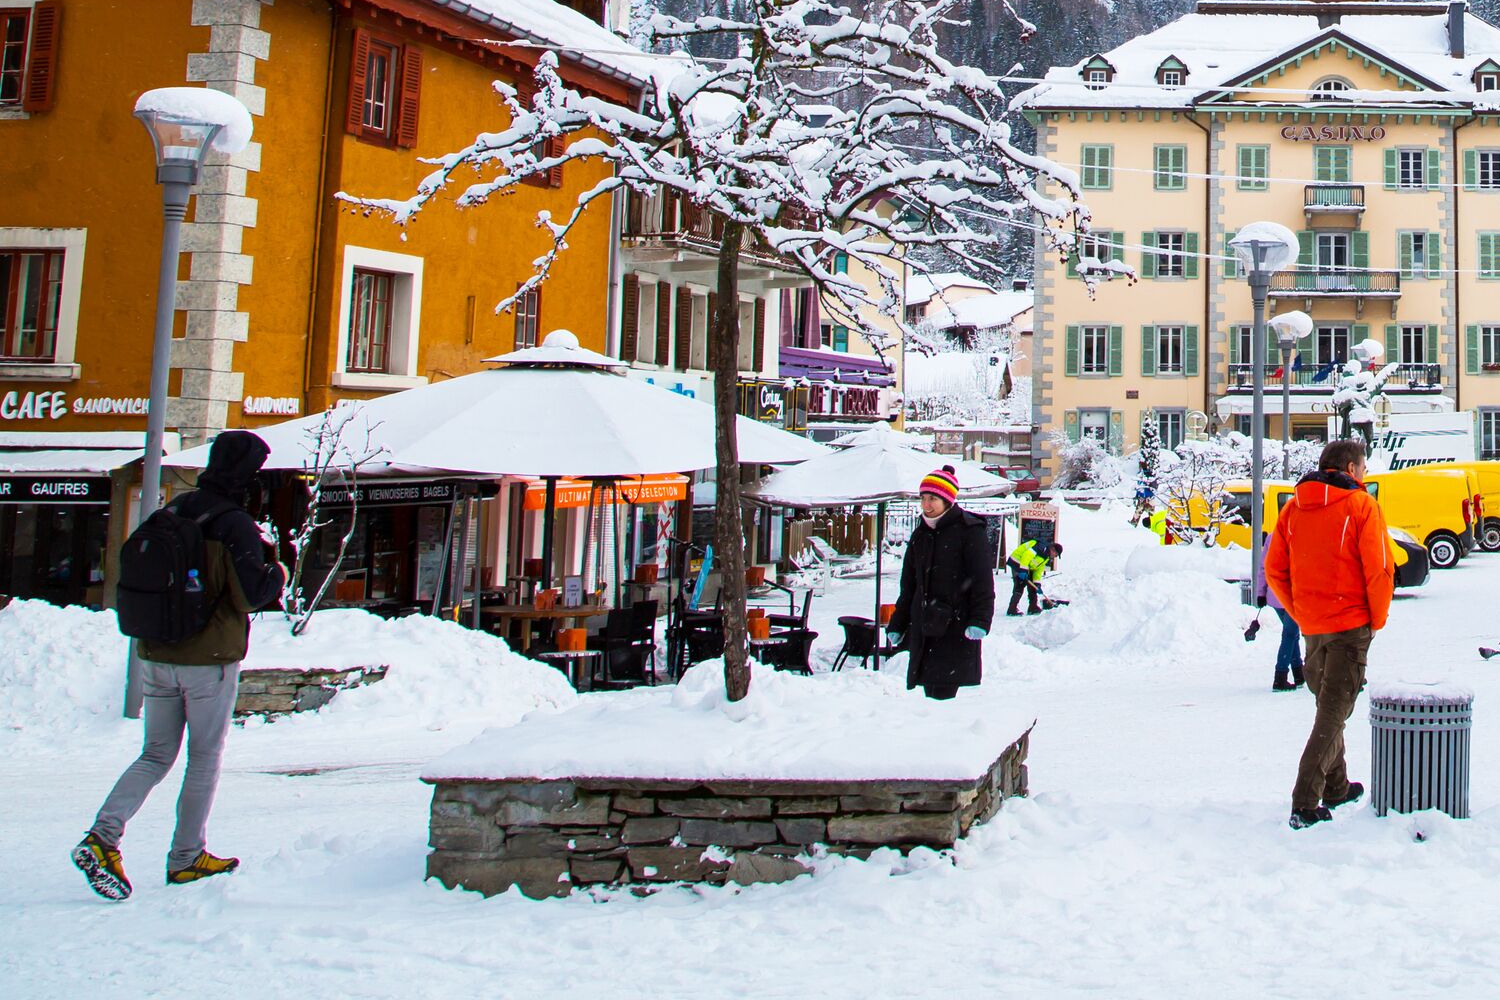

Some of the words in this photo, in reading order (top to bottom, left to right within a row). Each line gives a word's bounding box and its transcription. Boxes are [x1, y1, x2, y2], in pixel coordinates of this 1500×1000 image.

[1280, 126, 1386, 141] CASINO
[0, 391, 68, 419] CAFE
[73, 397, 150, 414] SANDWICH
[243, 396, 299, 414] SANDWICH
[31, 482, 89, 495] GAUFRES
[368, 487, 419, 500] VIENNOISERIES
[423, 485, 449, 498] BAGELS
[558, 490, 592, 503] ULTIMAT
[641, 485, 679, 498] SELECTION
